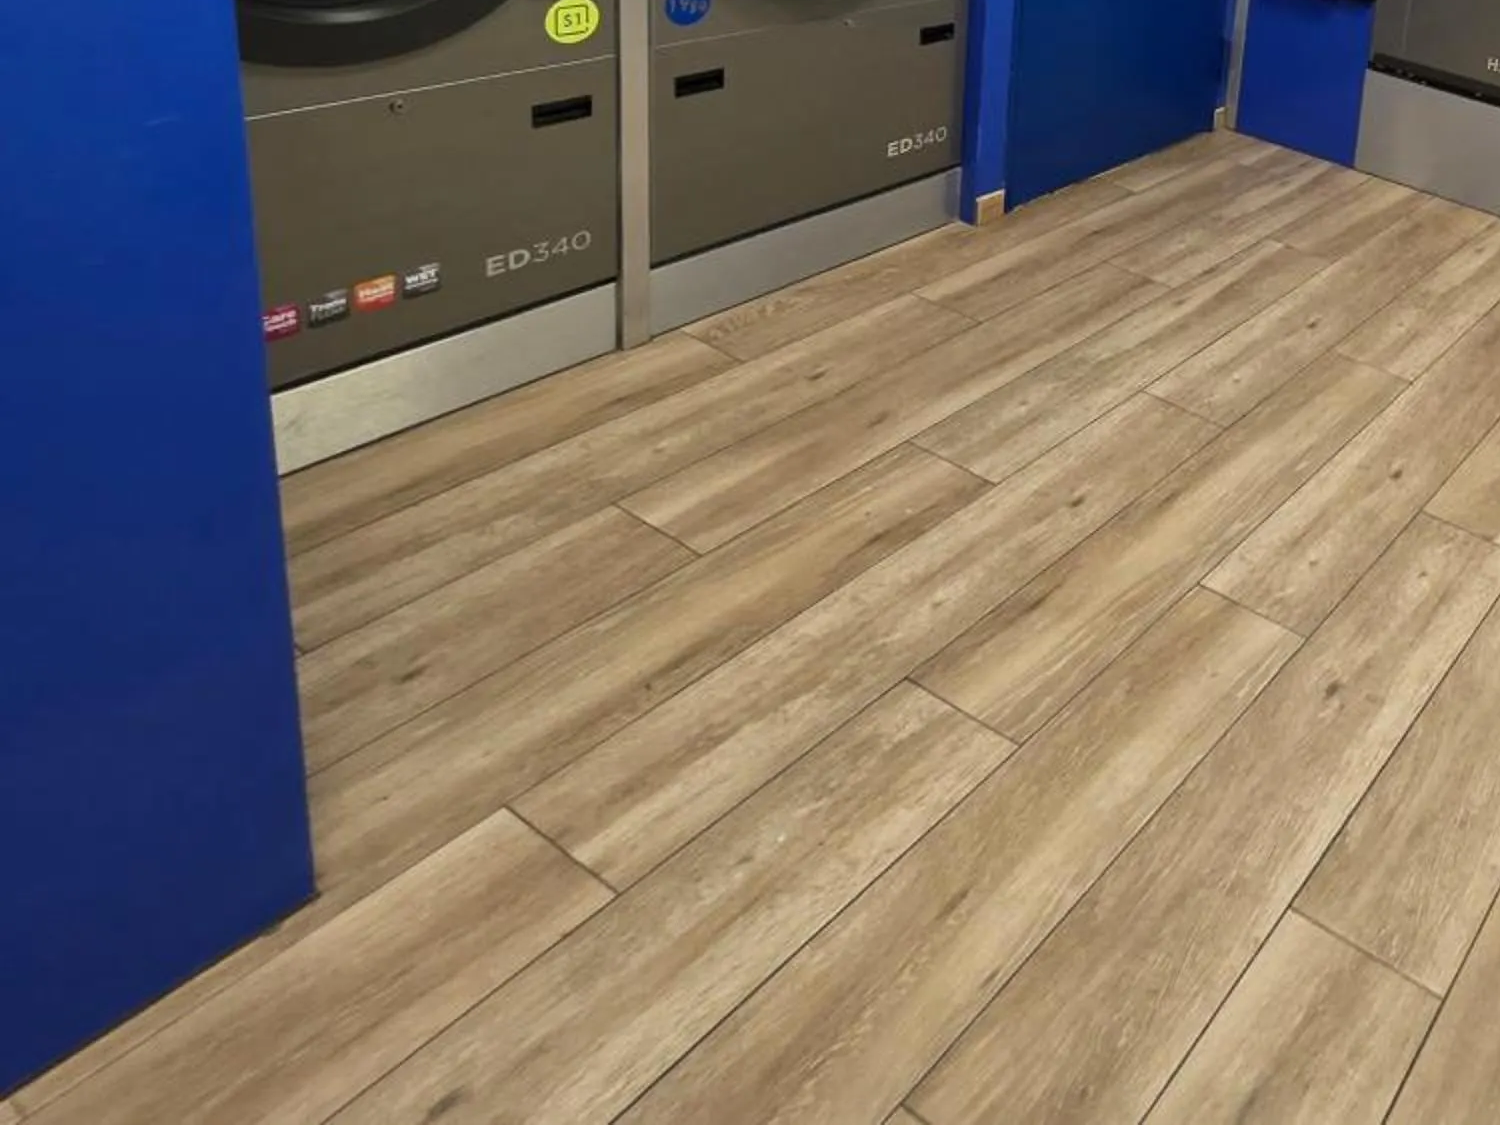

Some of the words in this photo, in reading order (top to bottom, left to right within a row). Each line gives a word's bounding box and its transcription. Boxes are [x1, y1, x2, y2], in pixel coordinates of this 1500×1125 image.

[563, 13, 581, 28] S1
[886, 126, 949, 158] ED340
[484, 230, 593, 278] ED340
